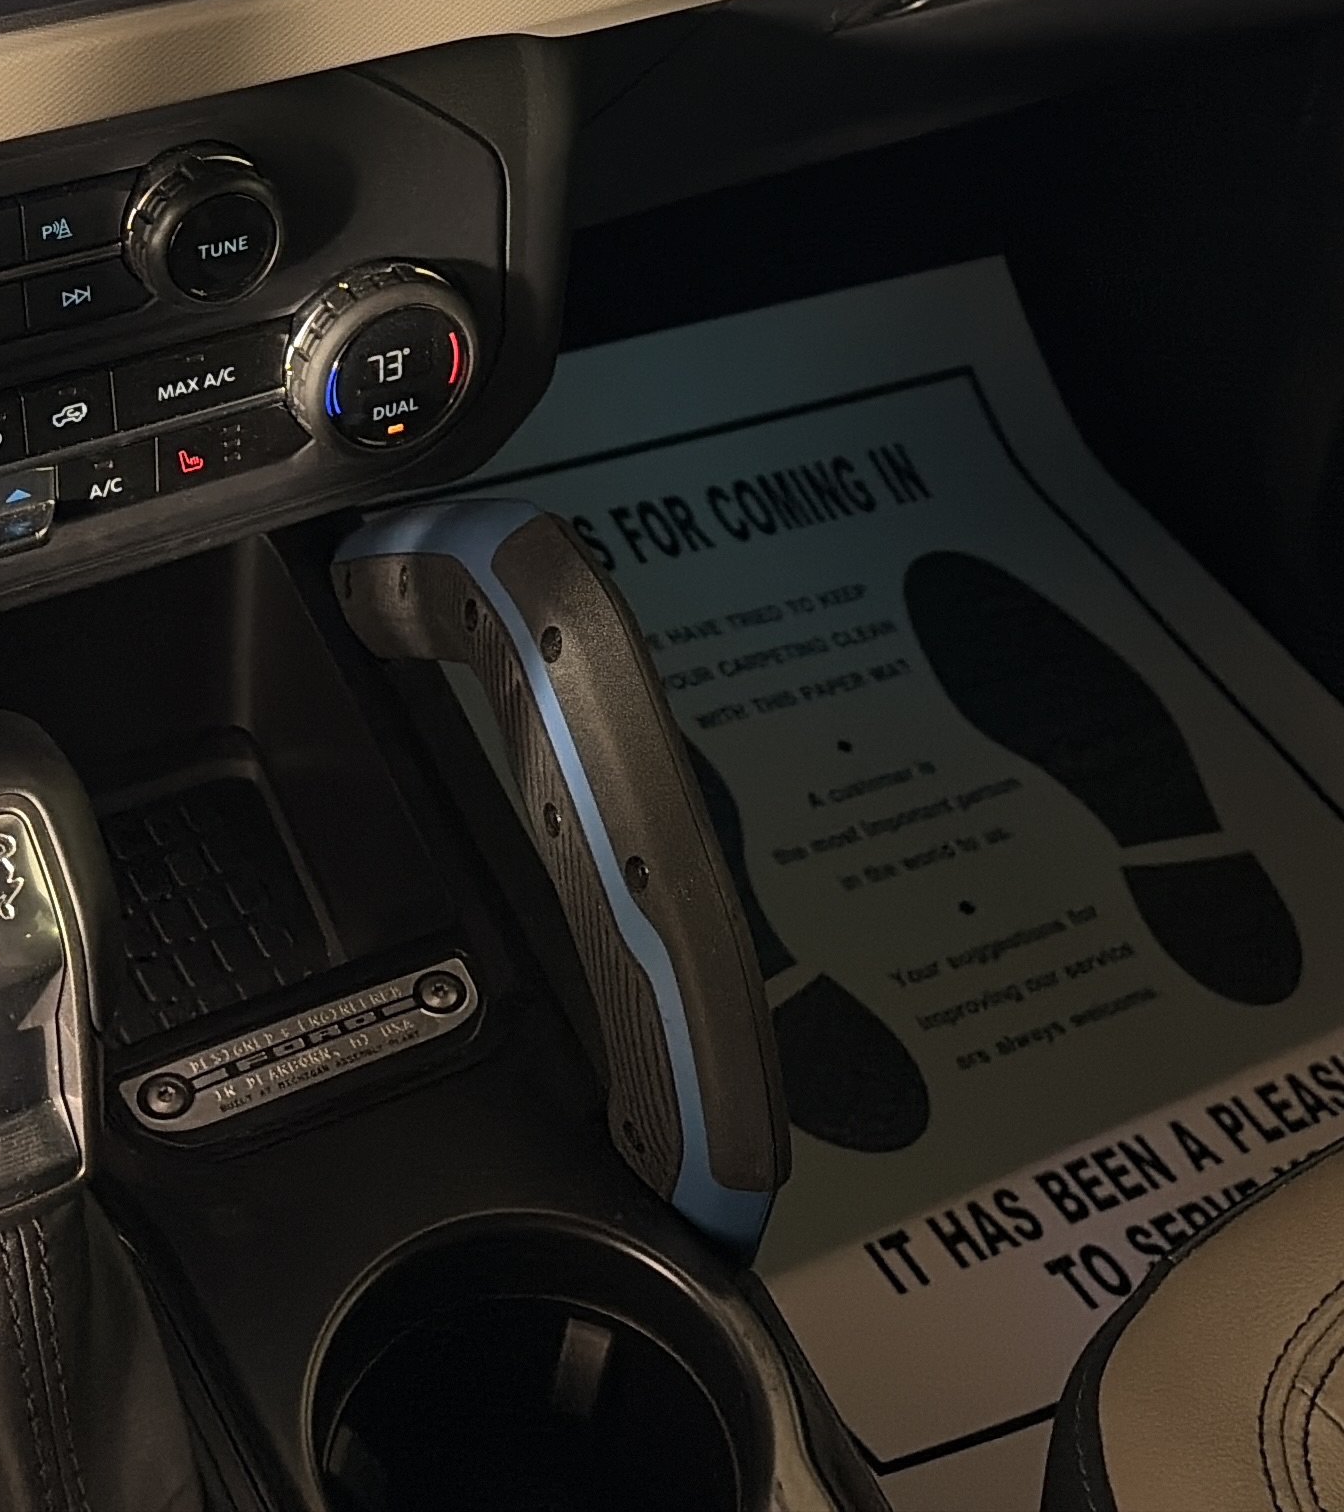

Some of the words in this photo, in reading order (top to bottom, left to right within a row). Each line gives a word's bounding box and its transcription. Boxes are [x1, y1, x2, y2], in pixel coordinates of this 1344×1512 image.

[198, 235, 249, 260] TUNE
[157, 373, 202, 402] MAX
[206, 364, 237, 393] A/C
[373, 395, 419, 422] DUAL
[89, 476, 124, 501] A/C
[608, 494, 717, 564] FOR
[706, 455, 877, 541] COMING
[868, 443, 934, 505] IN
[664, 619, 722, 645] HAVE
[785, 596, 815, 614] TO
[816, 584, 867, 609] KEEP
[831, 620, 897, 648] CLEAN
[697, 703, 749, 729] WITH
[233, 1010, 379, 1073] FORD
[862, 1228, 931, 1295] IT
[925, 1188, 1045, 1270] HAS
[1033, 1135, 1178, 1226] BEEN
[1168, 1120, 1225, 1174] A
[1044, 1244, 1133, 1311] TO
